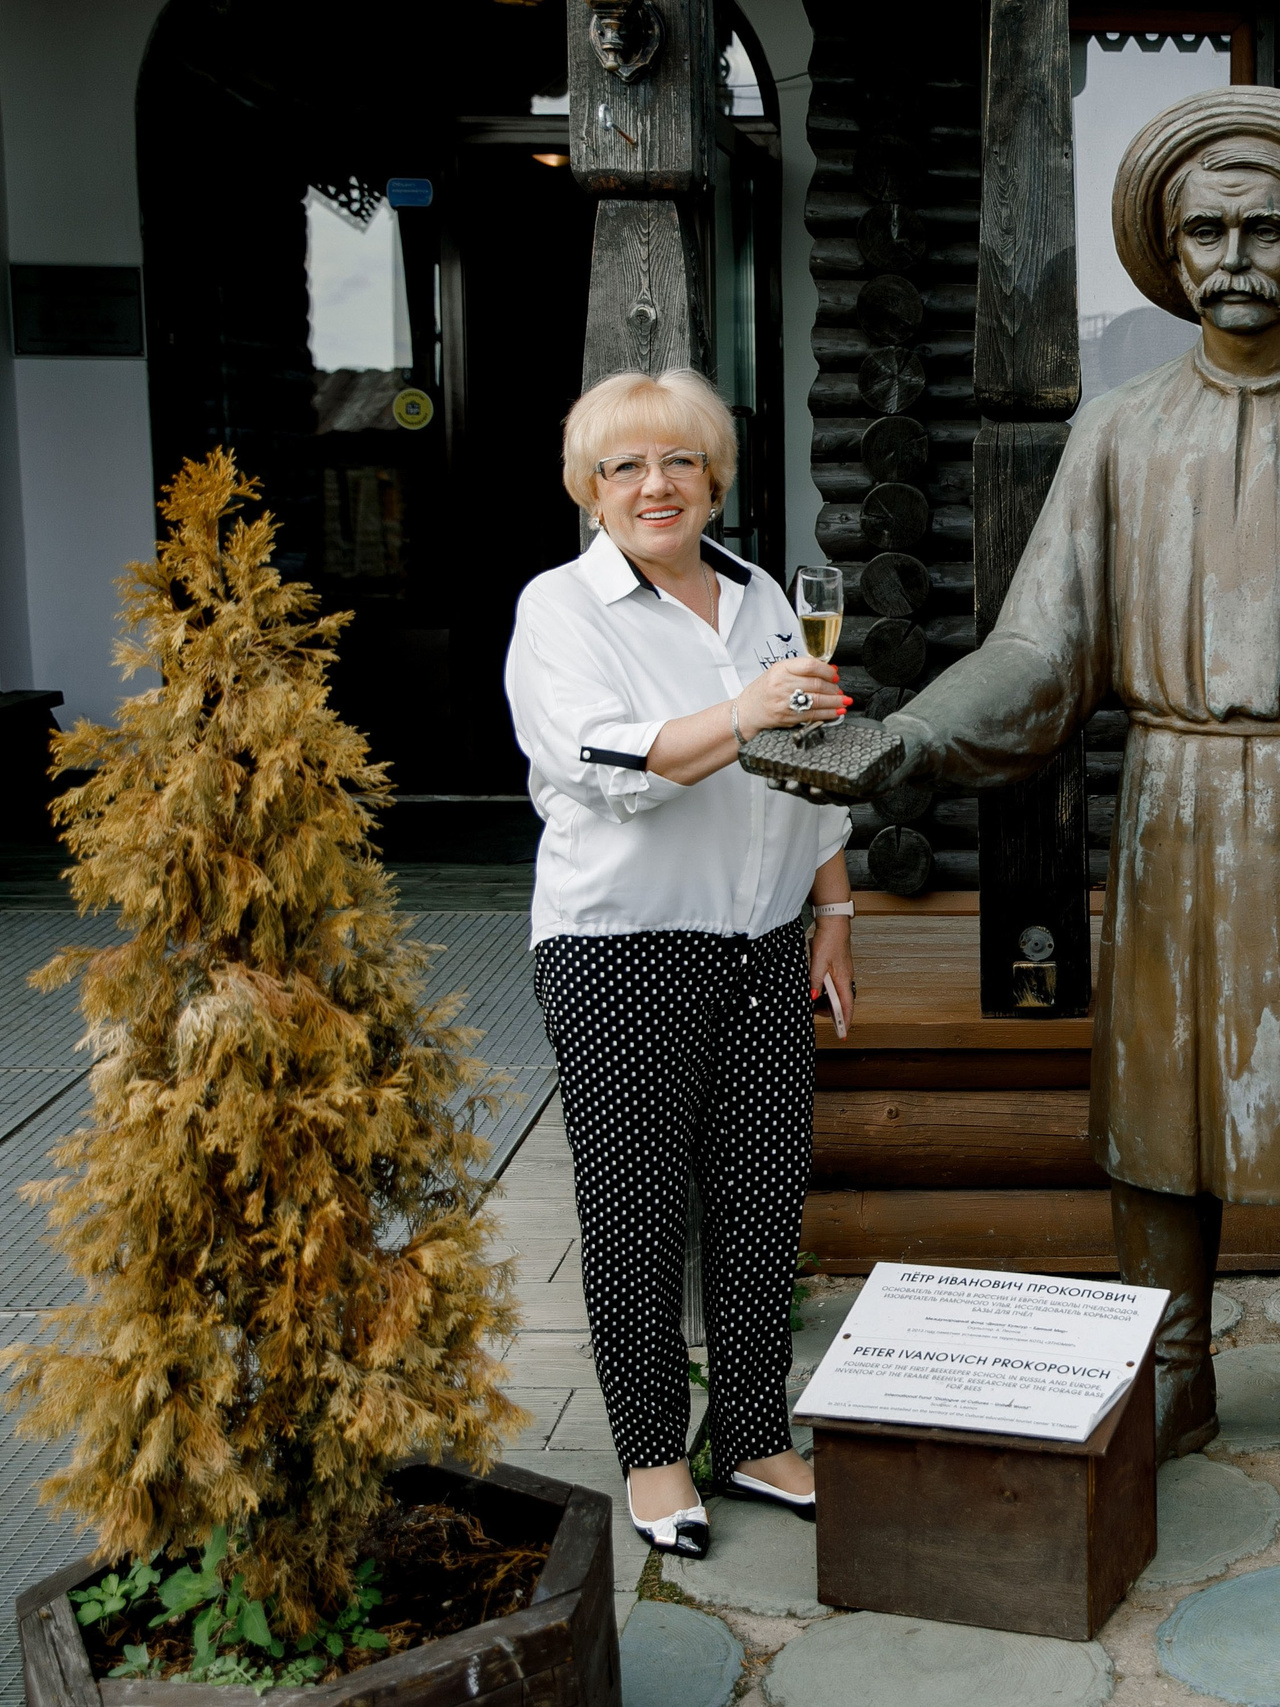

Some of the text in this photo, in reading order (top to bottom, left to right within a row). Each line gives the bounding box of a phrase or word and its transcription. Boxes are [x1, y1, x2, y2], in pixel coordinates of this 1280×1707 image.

[882, 1285, 933, 1295] ОСНОВАТЕЛЬ
[934, 1289, 966, 1297] ПЕРВОЙ
[973, 1293, 1009, 1301] РОССИИ
[1018, 1296, 1048, 1305] ЕВРОПЕ
[1050, 1300, 1081, 1309] ШКОЛЫ
[901, 1271, 1137, 1303] ПЁТР ИВАНОВИЧ ПРОКОПОВИЧ
[884, 1293, 938, 1302] ИЗОБРЕТАТЕЛЬ
[939, 1297, 990, 1306] РАМОЧНОГО
[1015, 1304, 1082, 1316] ИССЛЕДОВАТЕЛЬ
[1084, 1311, 1132, 1322] КОРМОВОЙ
[972, 1306, 994, 1314] БАЗЫ
[1012, 1310, 1034, 1318] ПЧЁЛ
[844, 1360, 881, 1369] FOUNDER
[930, 1367, 972, 1376] BEEKEEPER
[973, 1371, 1006, 1380] SCHOOL
[1019, 1375, 1047, 1384] RUSSIA
[1049, 1379, 1068, 1387] AND
[1069, 1381, 1102, 1392] EUROPE,
[854, 1346, 1111, 1379] PETER IVANOVICH PROKOPOVICH
[835, 1367, 875, 1376] INVENTOR
[904, 1372, 930, 1380] FRAME
[968, 1377, 1018, 1388] RESEARCHER
[1032, 1384, 1047, 1392] THE
[1049, 1386, 1083, 1396] FORAGE
[1084, 1390, 1105, 1399] BASE
